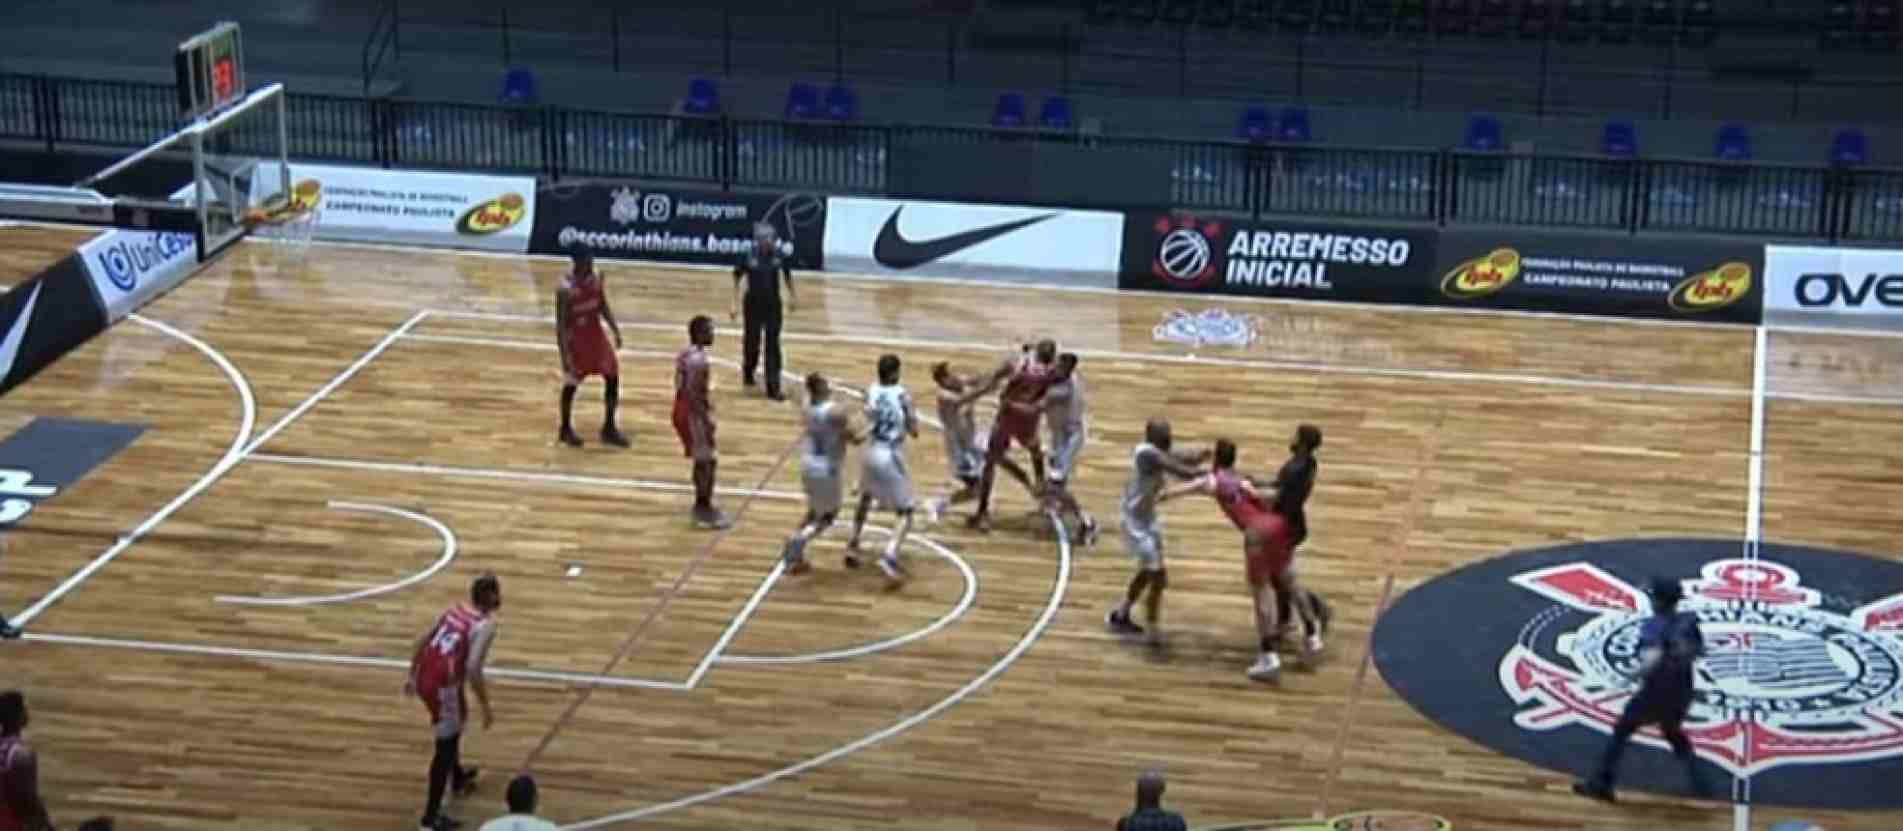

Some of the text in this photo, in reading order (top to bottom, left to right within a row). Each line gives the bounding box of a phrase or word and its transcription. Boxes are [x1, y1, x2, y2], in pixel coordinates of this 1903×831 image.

[1226, 231, 1409, 266] ARREMESSO
[1226, 259, 1332, 288] INICIAL
[1524, 273, 1608, 289] CAMPEONATO
